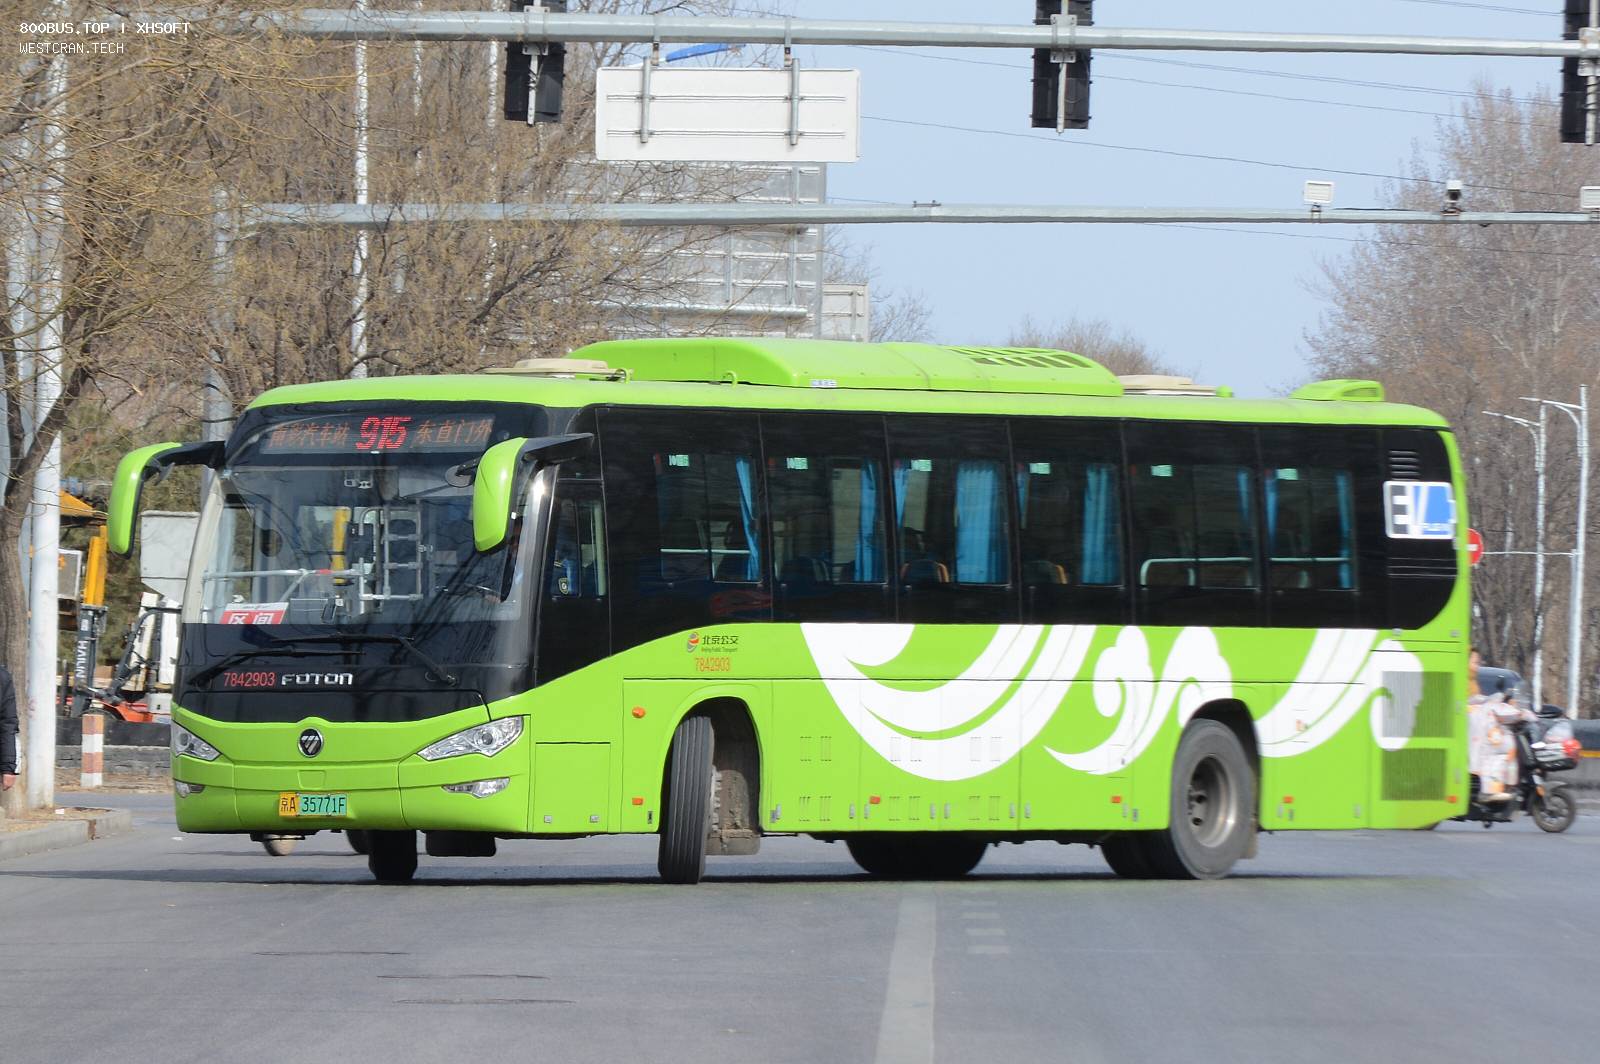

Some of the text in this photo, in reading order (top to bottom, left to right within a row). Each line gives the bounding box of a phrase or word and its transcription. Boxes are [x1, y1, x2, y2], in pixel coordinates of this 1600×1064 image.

[356, 416, 411, 450] 915
[415, 418, 494, 445] 东直门外
[702, 634, 739, 645] 北京公交
[695, 656, 731, 672] 7842903
[223, 671, 276, 688] 7842903
[281, 672, 354, 686] FOTON
